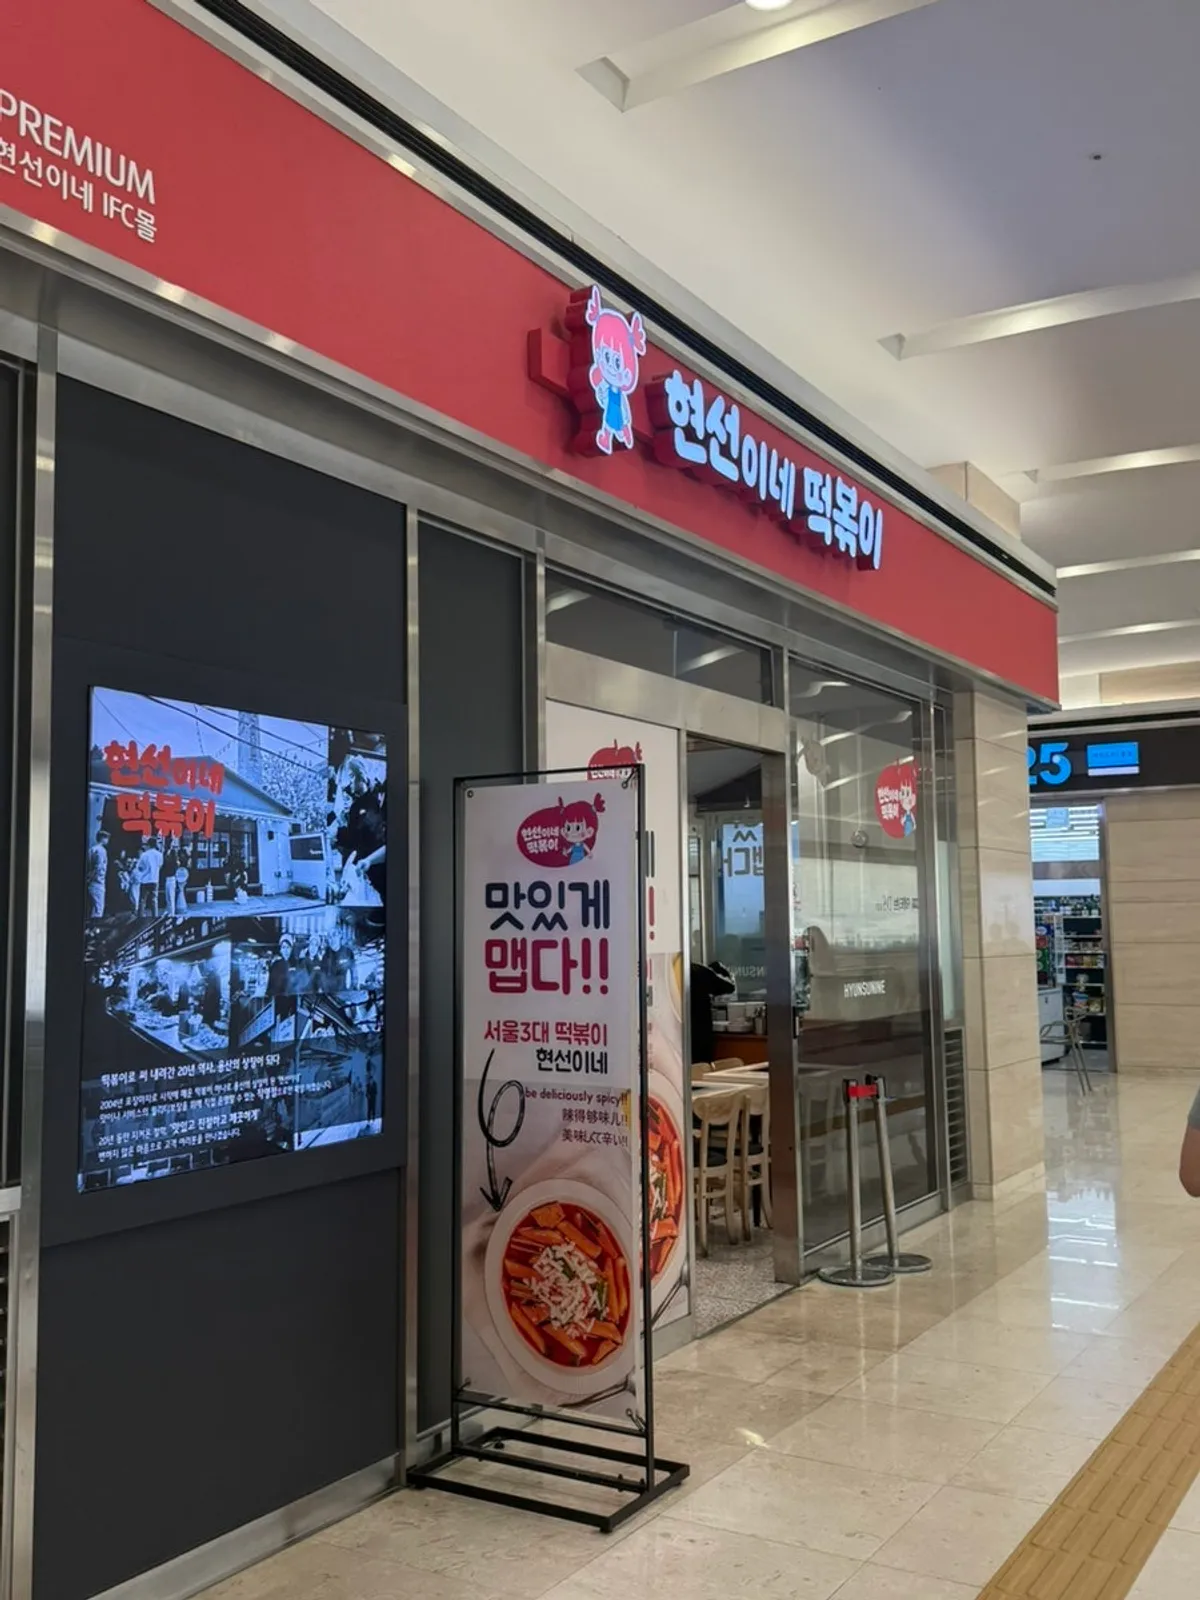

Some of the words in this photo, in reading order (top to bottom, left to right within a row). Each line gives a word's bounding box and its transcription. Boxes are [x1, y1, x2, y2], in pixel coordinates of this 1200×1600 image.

[0, 88, 155, 205] PREMIUM
[0, 137, 93, 213] 현선이네
[103, 192, 157, 243] IFC몰
[664, 369, 796, 520] 현선이네
[803, 466, 883, 570] 떡볶이
[103, 740, 225, 795] 현선이네
[116, 791, 215, 838] 떡볶이
[485, 879, 611, 931] 맛있게
[485, 937, 609, 995] 맵다!!
[484, 1020, 549, 1043] 서울3대
[555, 1021, 607, 1046] 떡볶이
[536, 1048, 608, 1074] 현선이네
[525, 1087, 537, 1098] be
[540, 1088, 593, 1104] deliciously
